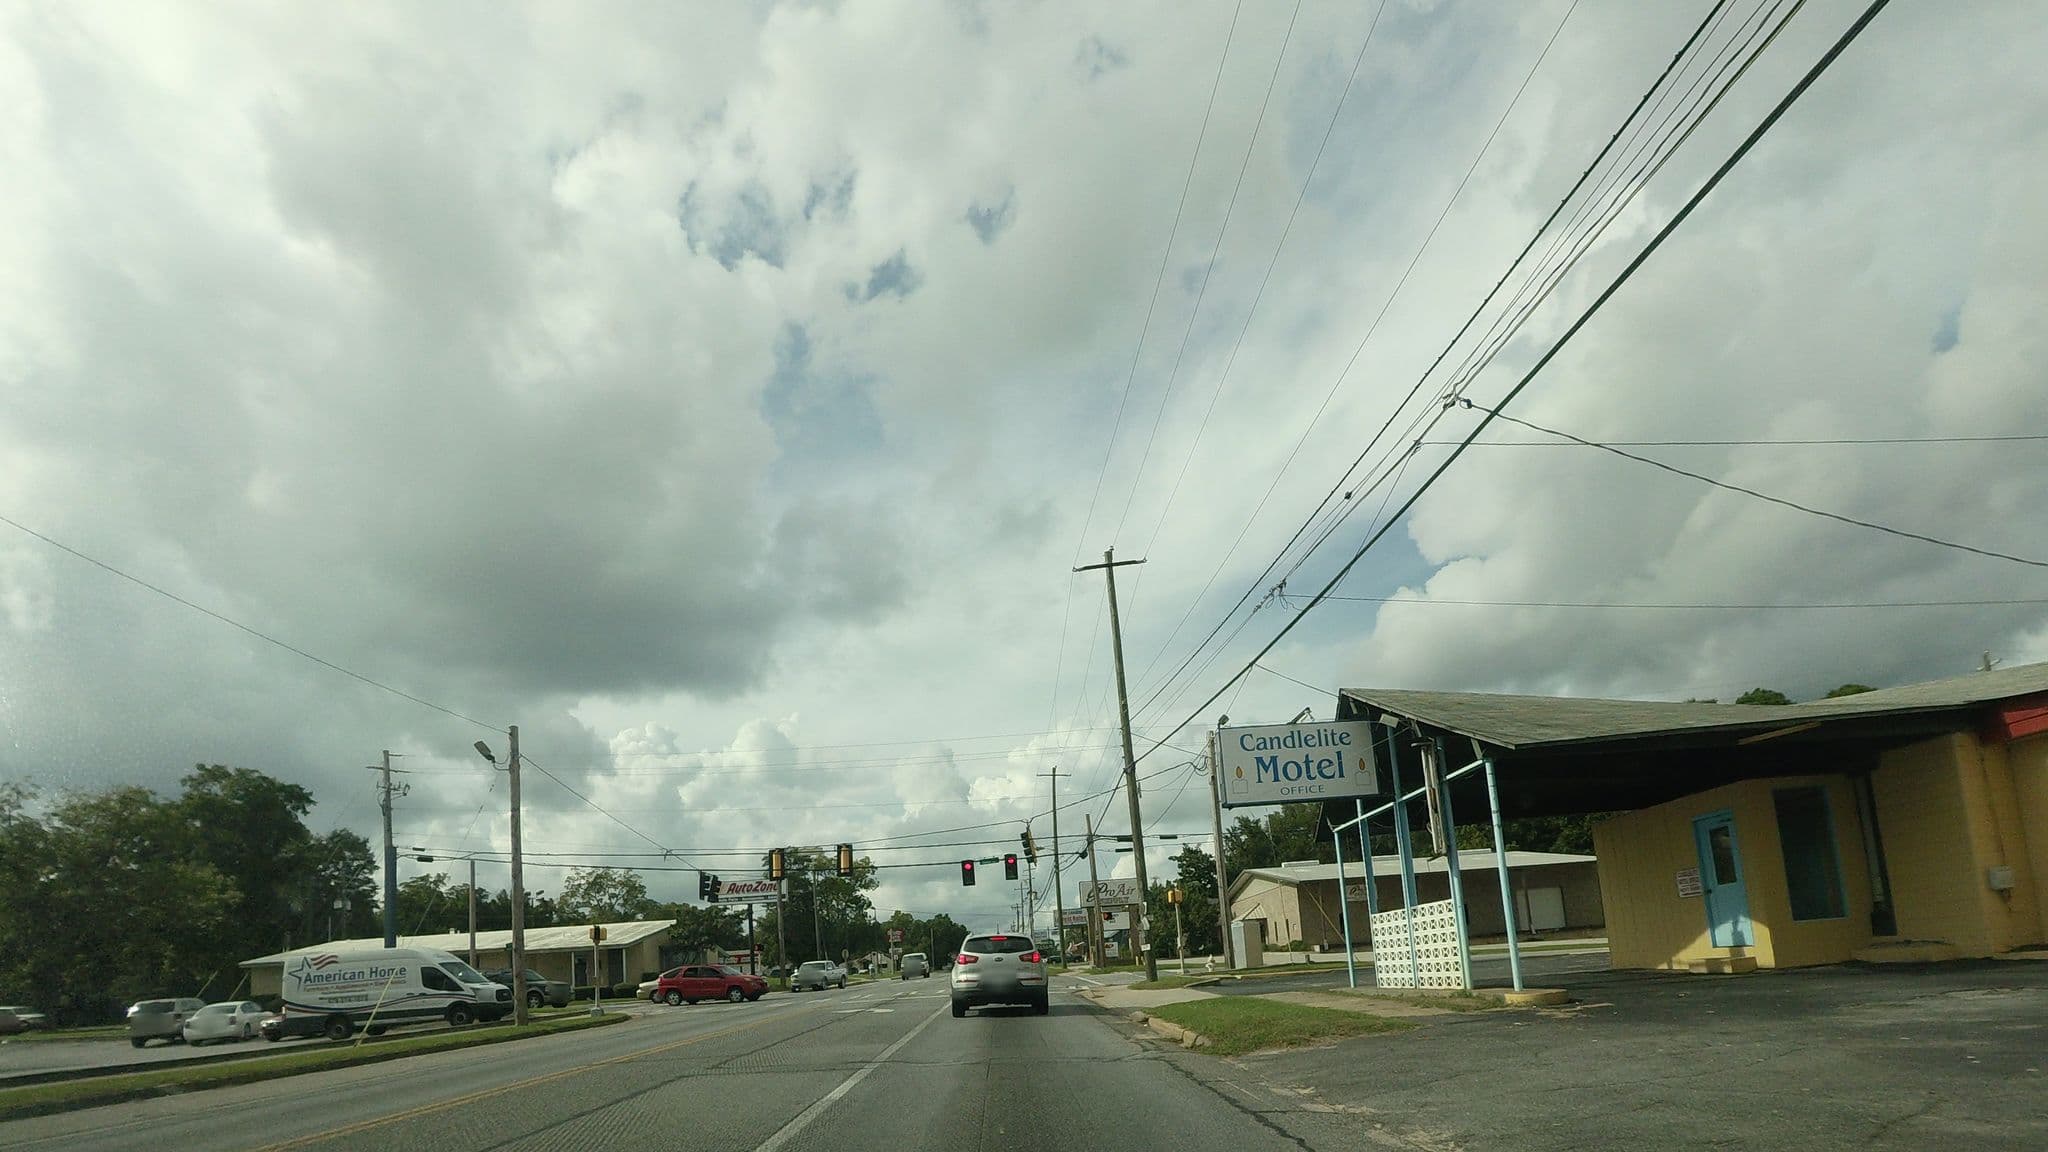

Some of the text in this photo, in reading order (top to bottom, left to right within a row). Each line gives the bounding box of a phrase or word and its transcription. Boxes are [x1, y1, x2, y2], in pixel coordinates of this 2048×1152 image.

[1239, 728, 1352, 752] Candlelite
[1254, 750, 1346, 784] Motel
[1280, 785, 1326, 796] OFFICE
[1114, 883, 1136, 897] Air
[303, 969, 365, 984] American
[369, 966, 407, 979] Home
